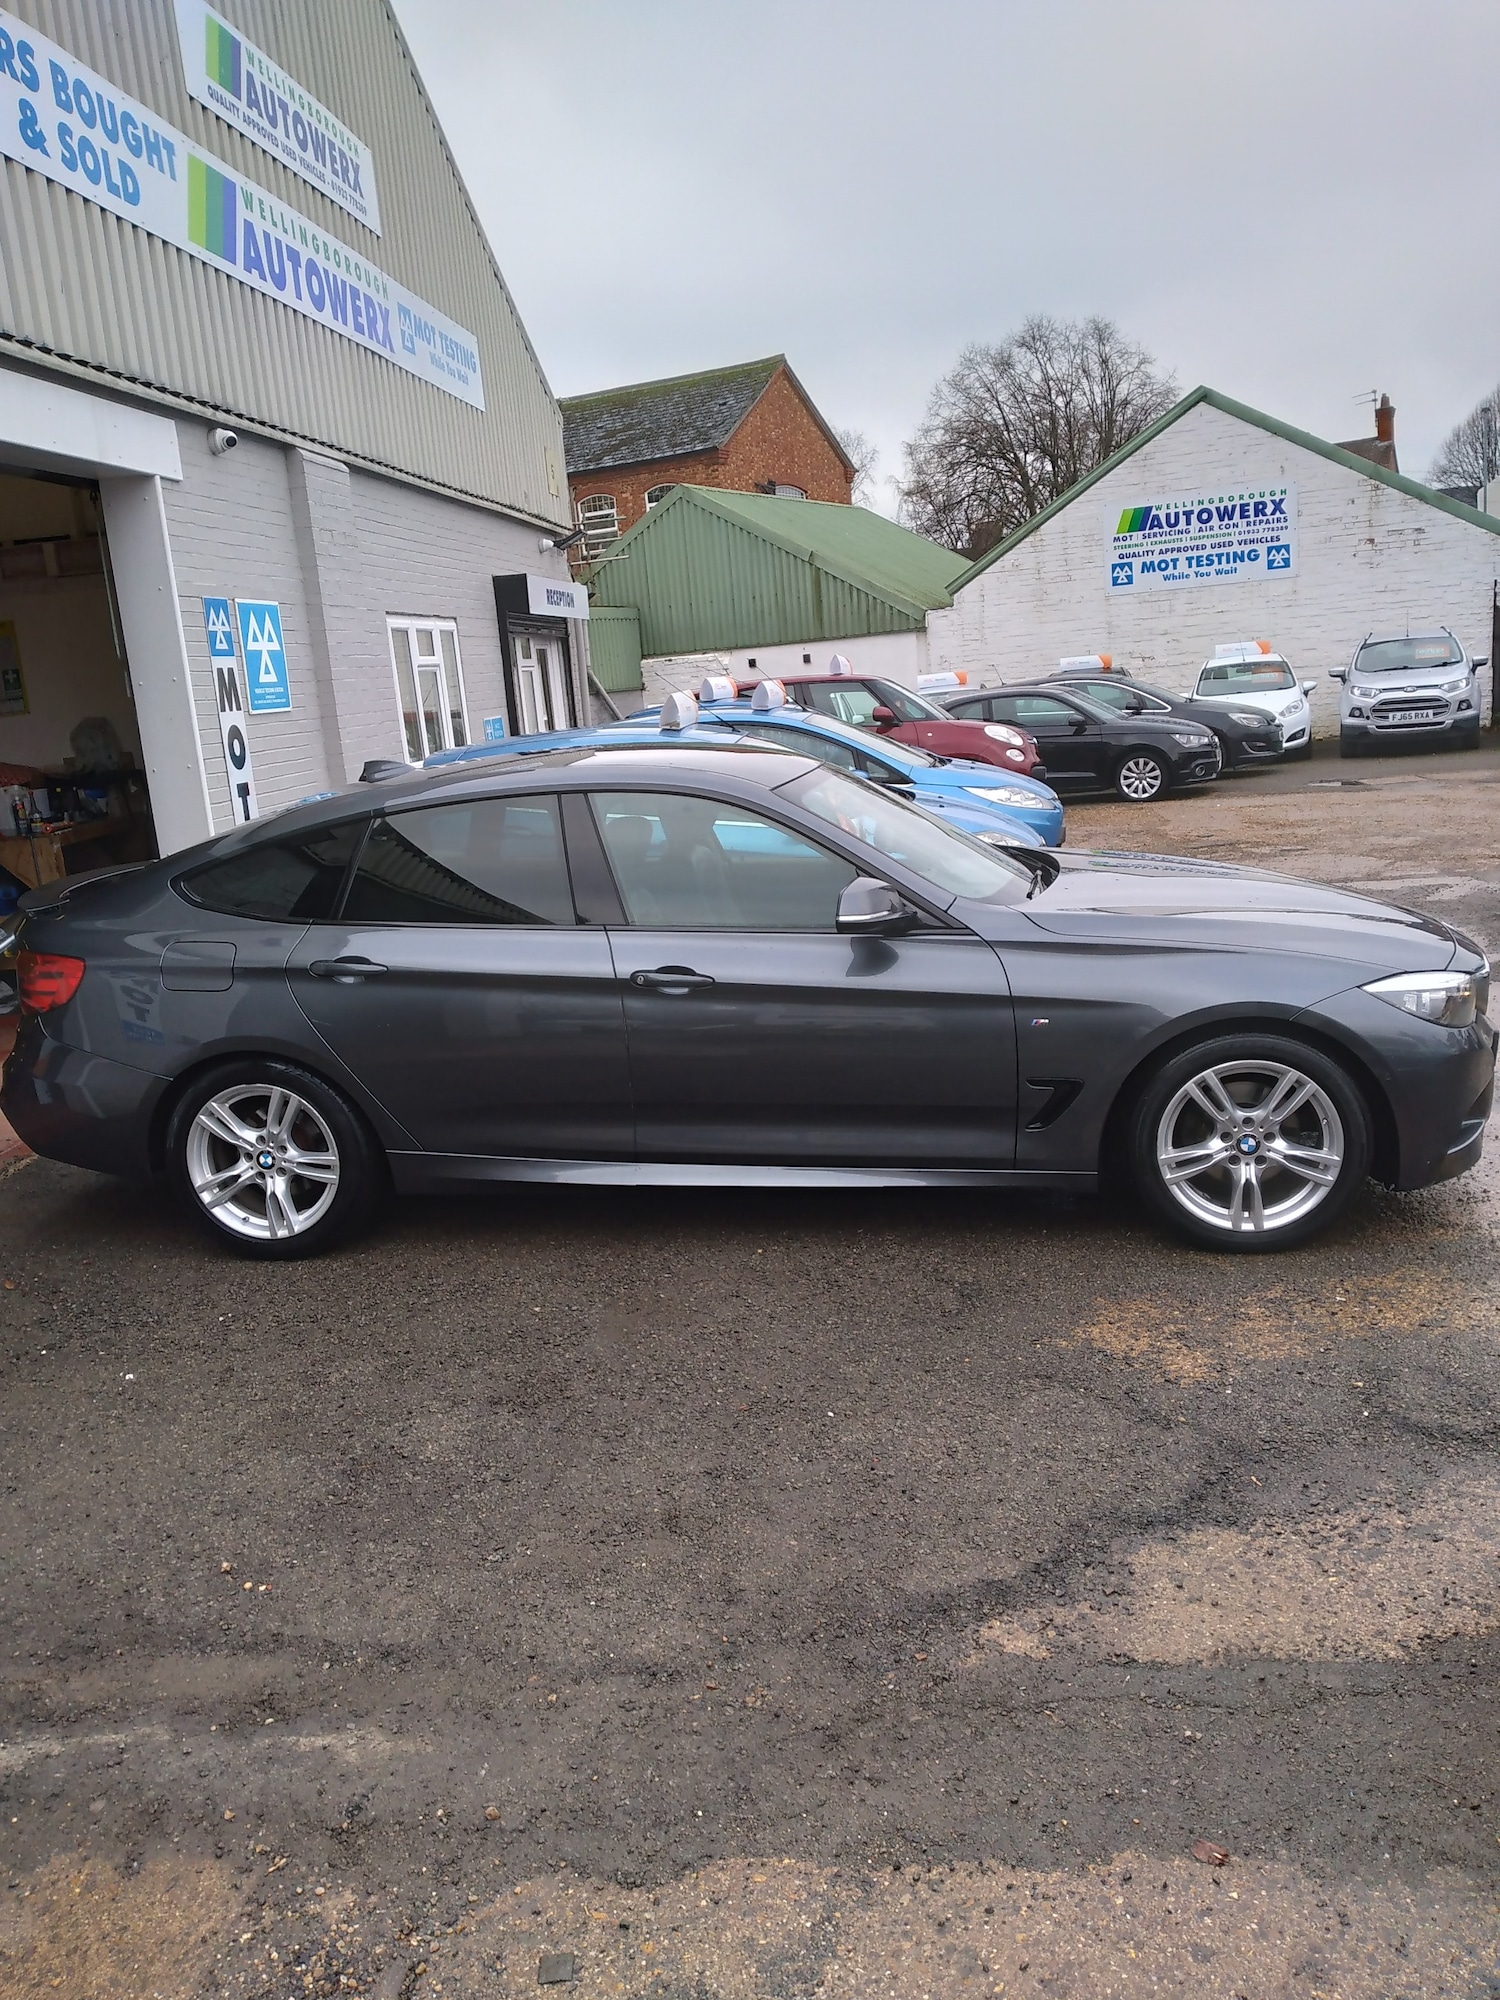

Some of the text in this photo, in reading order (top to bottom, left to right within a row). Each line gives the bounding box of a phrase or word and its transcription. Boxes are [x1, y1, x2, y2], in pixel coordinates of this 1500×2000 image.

[48, 58, 177, 182] BOUGHT
[245, 46, 360, 158] WELLINGBOROUGH
[18, 97, 140, 206] & SOLD
[207, 84, 240, 119] QUALITY
[242, 111, 279, 147] APPROVED
[280, 140, 297, 162] USED
[299, 154, 326, 184] VEHICLES
[246, 69, 365, 200] AUTOWERX
[240, 186, 388, 300] WELLINGBOROUGH
[243, 218, 395, 354] AUTOWERX
[413, 313, 477, 374] MOT TESTING
[429, 350, 469, 386] While You Wait
[1148, 498, 1287, 531] AUTOWERX
[1155, 488, 1287, 511] WELLINGBOROUGH
[1113, 516, 1288, 543] MOT SERVICING AIR CON REPAIRS
[1113, 542, 1144, 551] STEERING
[1150, 537, 1184, 546] EXHAUSTS
[1189, 532, 1232, 541] SUSPENSION
[1118, 535, 1281, 560] QUALITY APPROVED USED VEHICLES
[1141, 548, 1260, 573] MOT TESTING
[1162, 566, 1238, 581] While You Wait
[546, 588, 575, 608] RECEPTION
[1392, 711, 1430, 721] FJ65 RXA
[216, 667, 250, 821] MOT
